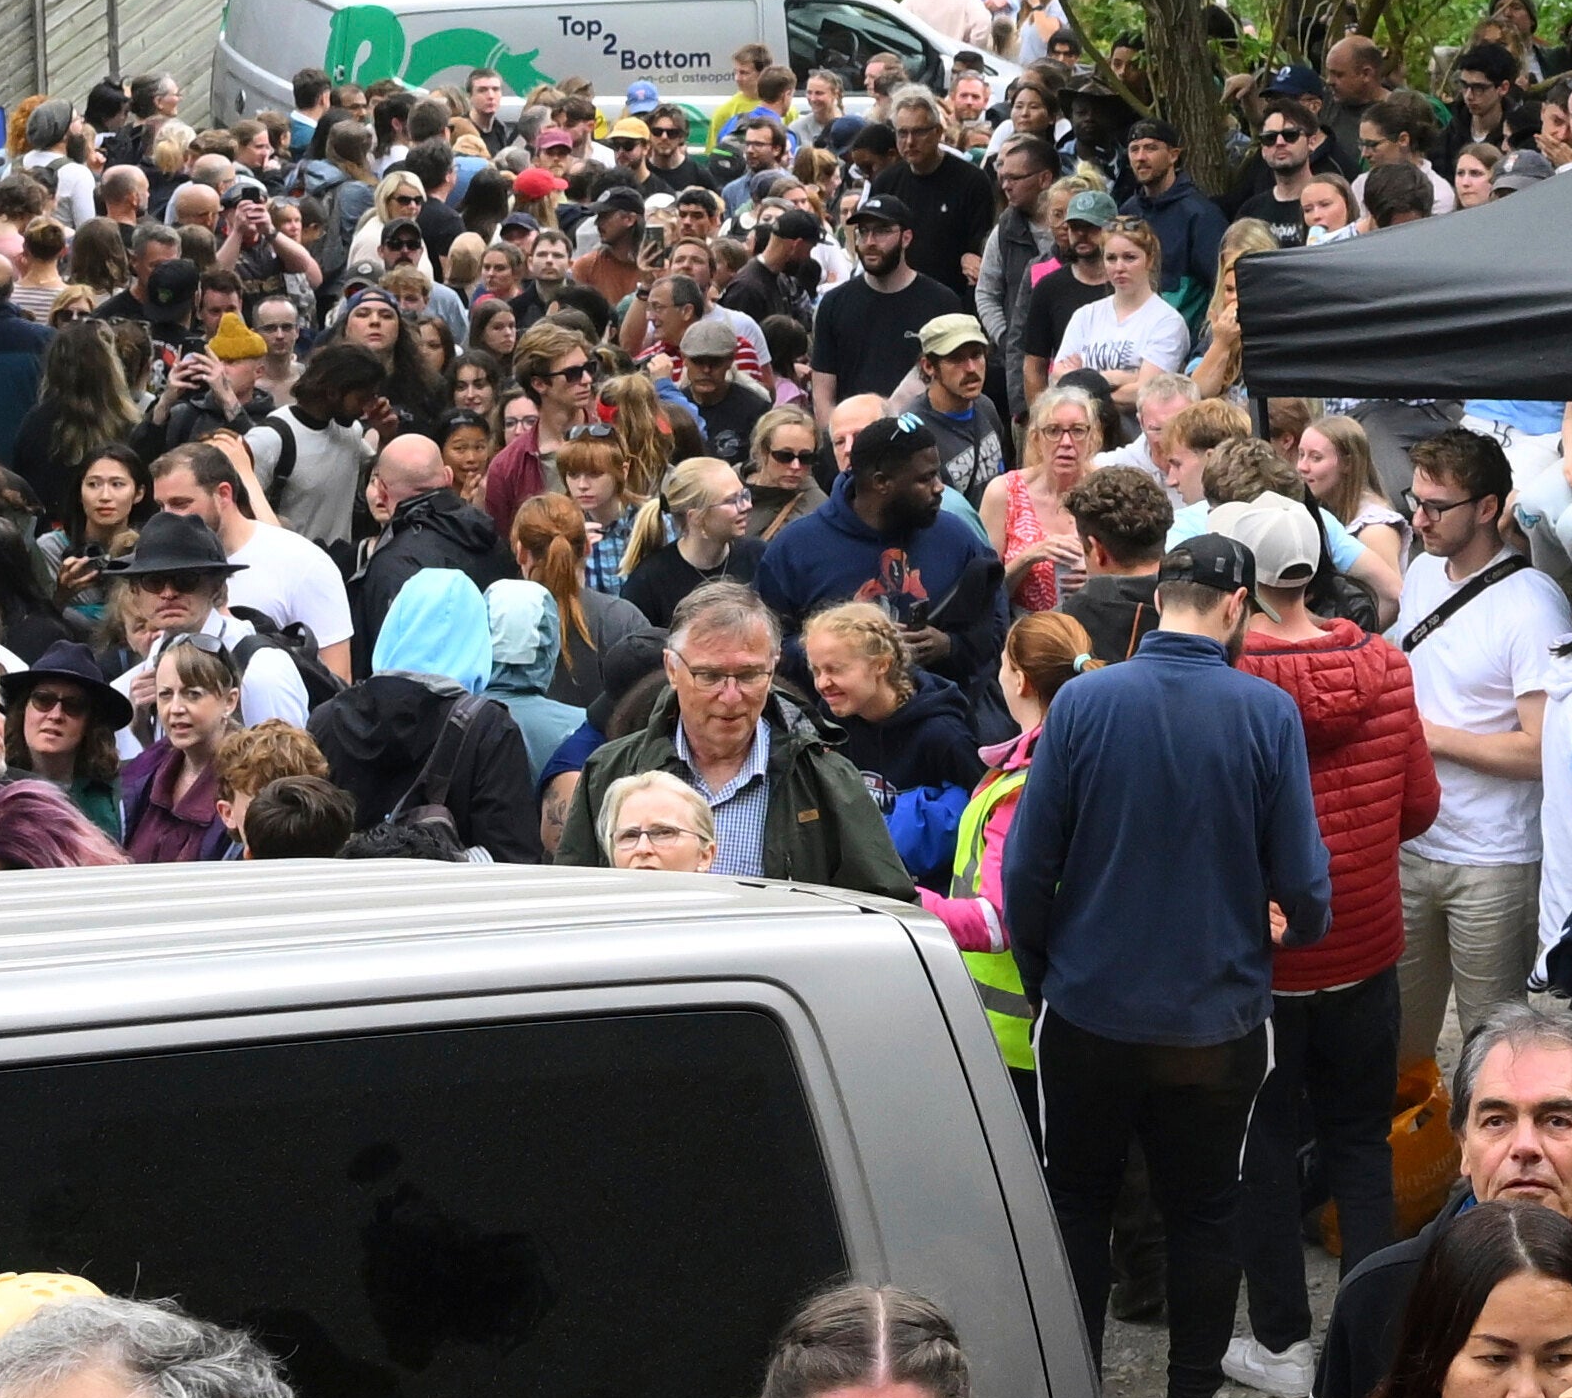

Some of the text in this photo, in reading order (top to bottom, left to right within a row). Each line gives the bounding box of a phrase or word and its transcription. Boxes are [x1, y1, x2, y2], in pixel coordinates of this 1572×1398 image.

[558, 14, 602, 41] Top
[602, 33, 618, 56] 2
[620, 49, 712, 70] Bottom
[1484, 562, 1517, 584] Canon
[1411, 623, 1429, 644] EOS
